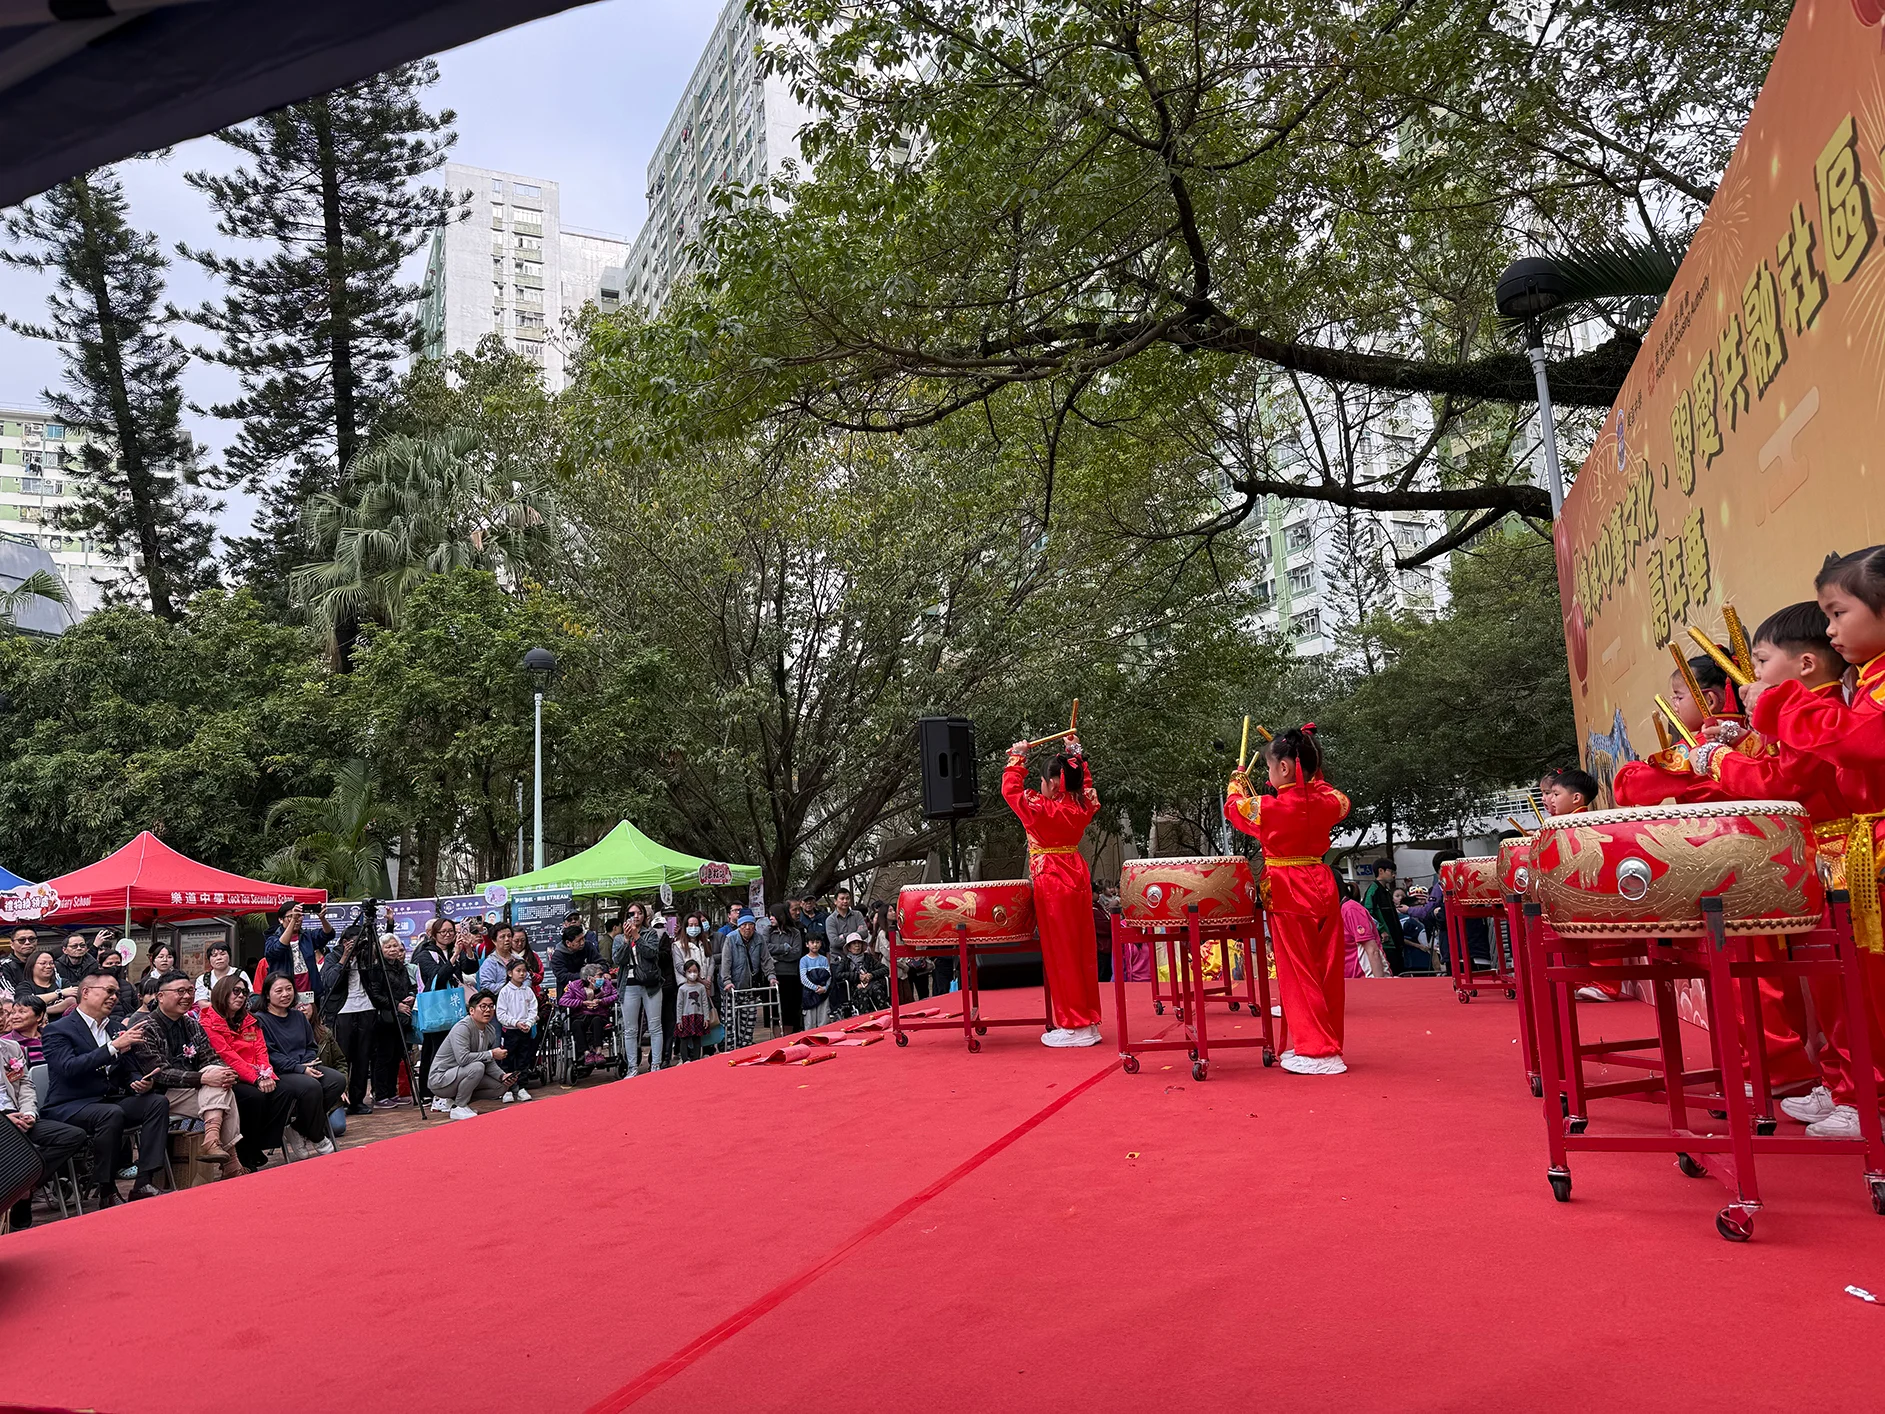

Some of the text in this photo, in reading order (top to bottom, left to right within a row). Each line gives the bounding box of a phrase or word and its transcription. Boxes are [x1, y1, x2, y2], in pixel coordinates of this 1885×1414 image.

[1646, 506, 1711, 650] 嘉年華
[583, 879, 610, 889] Secondary
[610, 877, 628, 886] School
[73, 895, 92, 907] School
[171, 892, 225, 905] 樂道中學
[250, 894, 278, 907] Secondary
[277, 894, 295, 905] School
